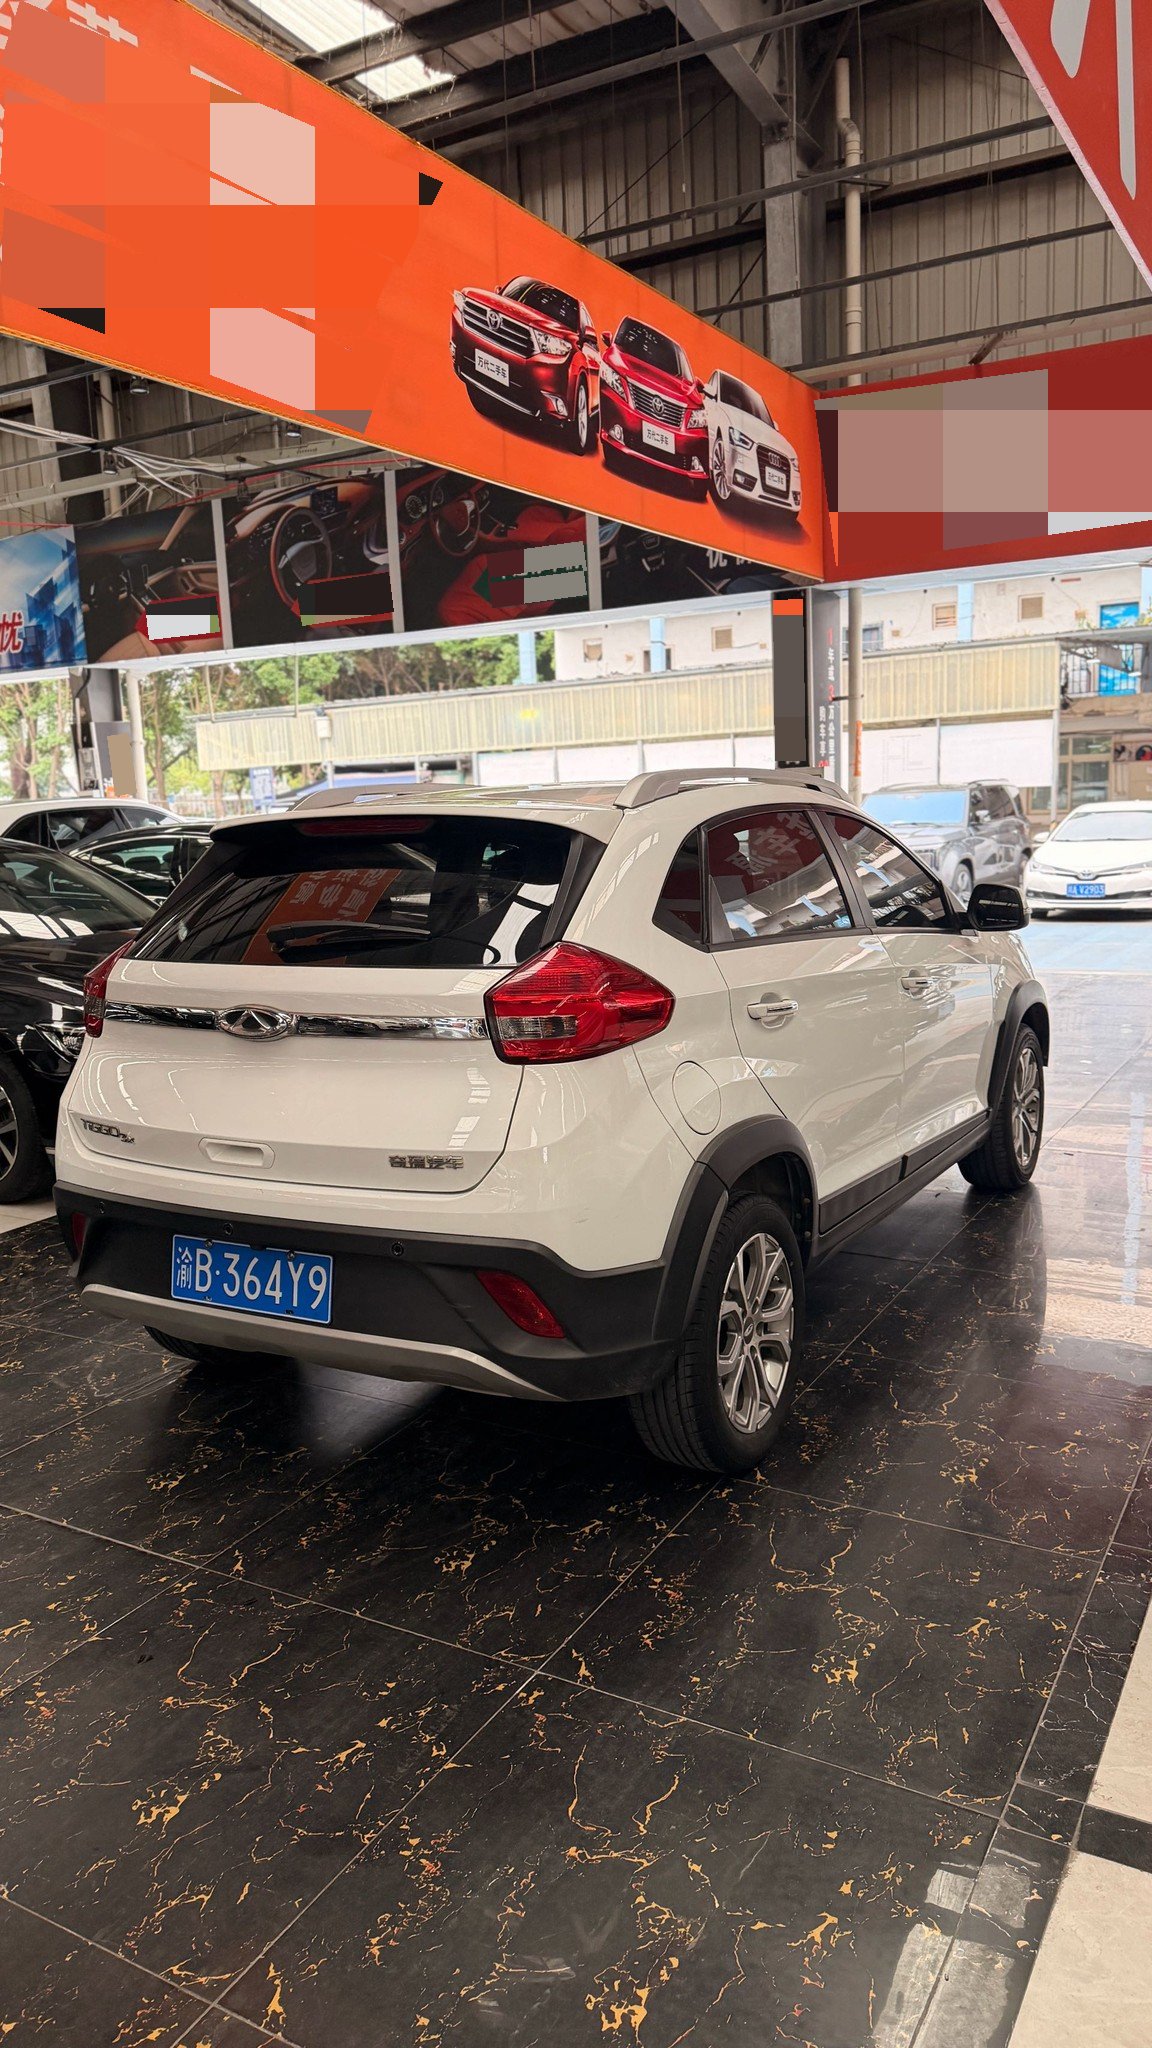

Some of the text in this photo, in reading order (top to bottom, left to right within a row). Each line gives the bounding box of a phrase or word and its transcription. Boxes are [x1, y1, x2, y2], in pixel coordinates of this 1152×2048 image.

[477, 355, 508, 379] 万代二手车
